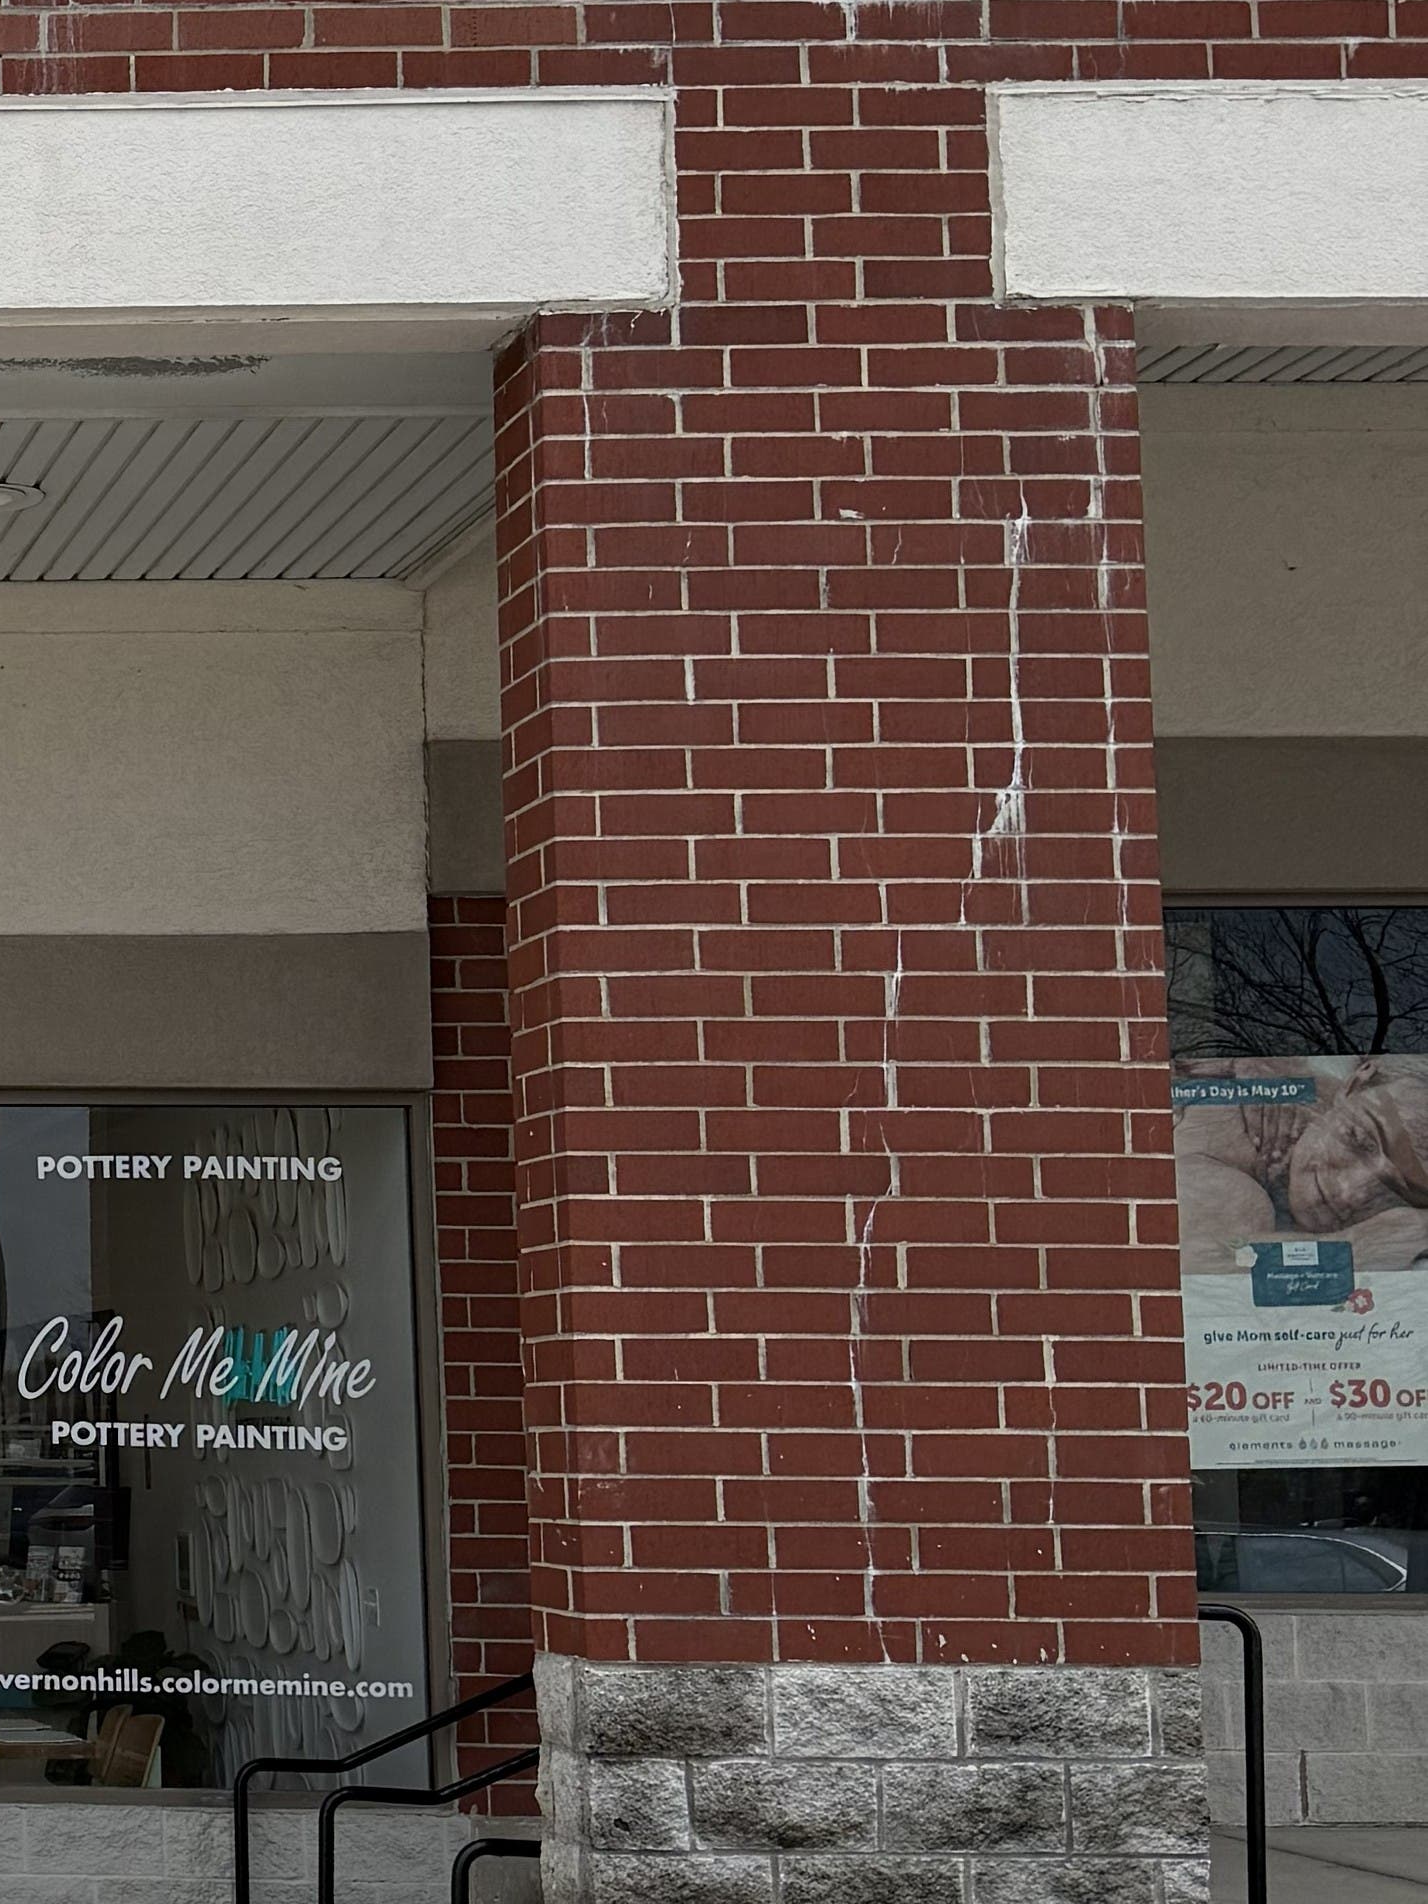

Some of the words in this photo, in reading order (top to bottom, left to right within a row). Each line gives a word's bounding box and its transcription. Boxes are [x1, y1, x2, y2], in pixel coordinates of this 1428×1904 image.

[1209, 1086, 1235, 1100] Day
[1237, 1085, 1249, 1097] is
[1251, 1084, 1279, 1098] May
[37, 1155, 172, 1180] POTTERY
[184, 1155, 343, 1182] PAINTING
[1203, 1330, 1234, 1345] give
[1236, 1330, 1272, 1342] Mom
[1274, 1329, 1335, 1342] self-care
[1335, 1324, 1366, 1351] just
[1367, 1322, 1387, 1345] for
[1389, 1320, 1415, 1339] her
[17, 1316, 153, 1400] Color
[159, 1326, 240, 1400] Me
[253, 1327, 378, 1412] Mine
[1187, 1381, 1248, 1412] $20
[1251, 1391, 1295, 1410] OFF
[1328, 1378, 1392, 1409] $30
[1395, 1388, 1428, 1408] OF
[51, 1420, 185, 1449] POTTERY
[196, 1424, 349, 1452] PAINTING
